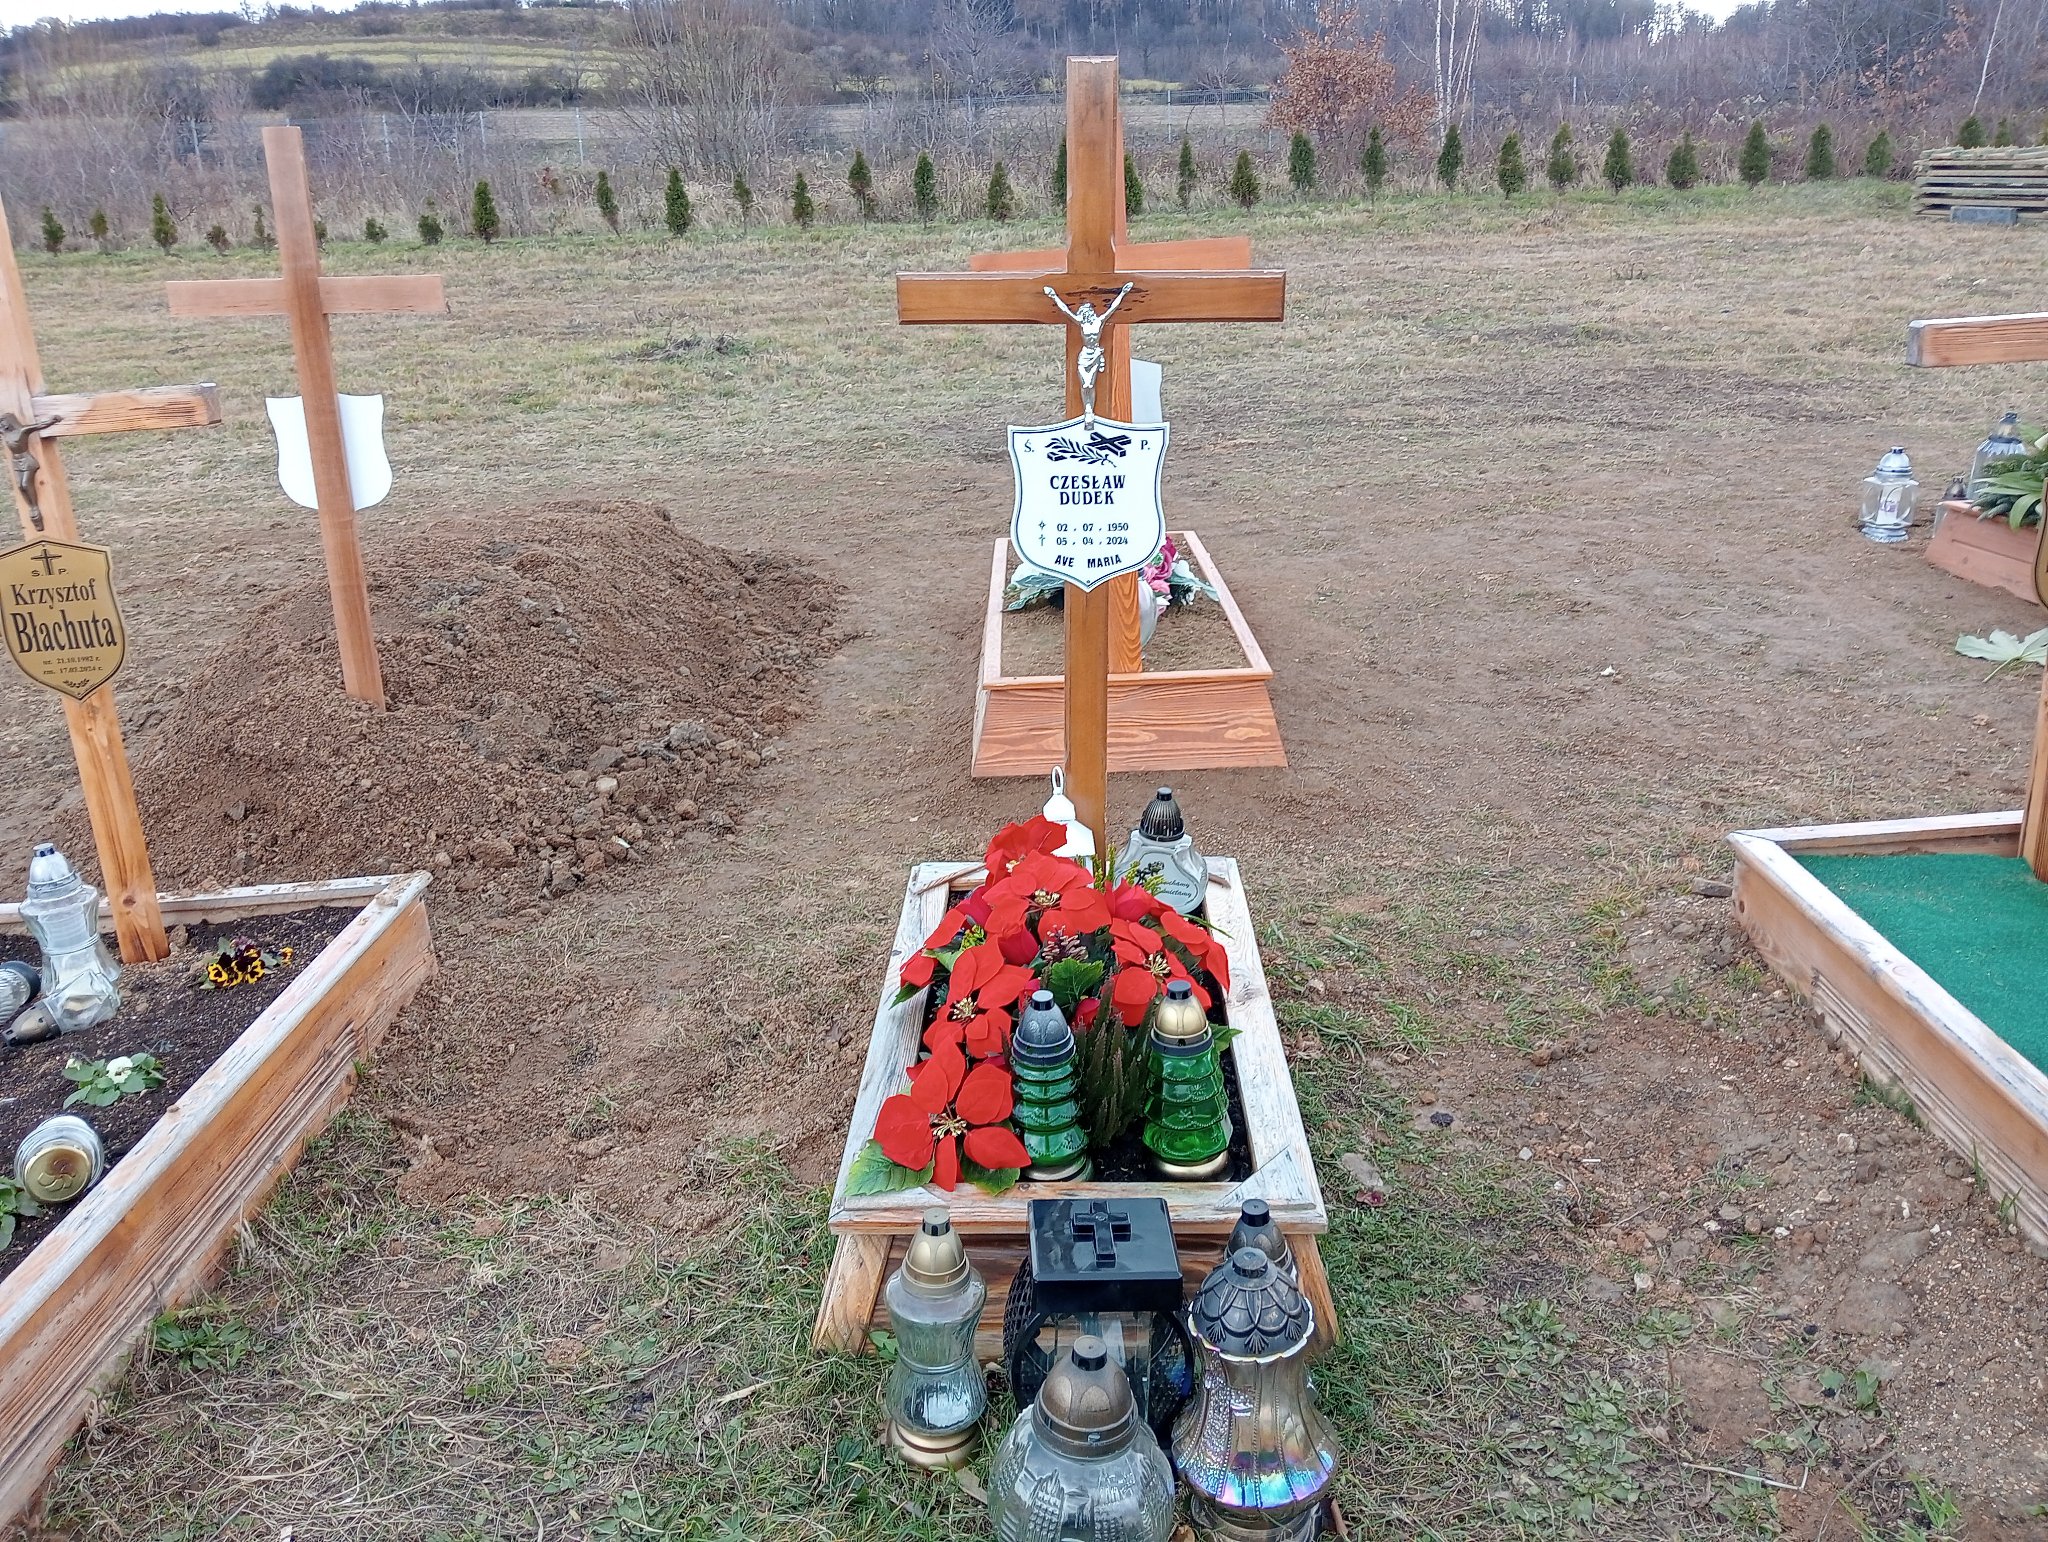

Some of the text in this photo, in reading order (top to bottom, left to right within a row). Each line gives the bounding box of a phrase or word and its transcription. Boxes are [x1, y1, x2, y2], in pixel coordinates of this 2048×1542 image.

[1049, 474, 1126, 490] CZESŁAW
[1059, 490, 1115, 505] DUDEK
[1107, 522, 1129, 532] 1950
[1106, 536, 1129, 546] 2024
[1054, 554, 1122, 568] AVE MARIA
[10, 578, 97, 610] Krzysztof
[10, 610, 118, 654] Błachuta
